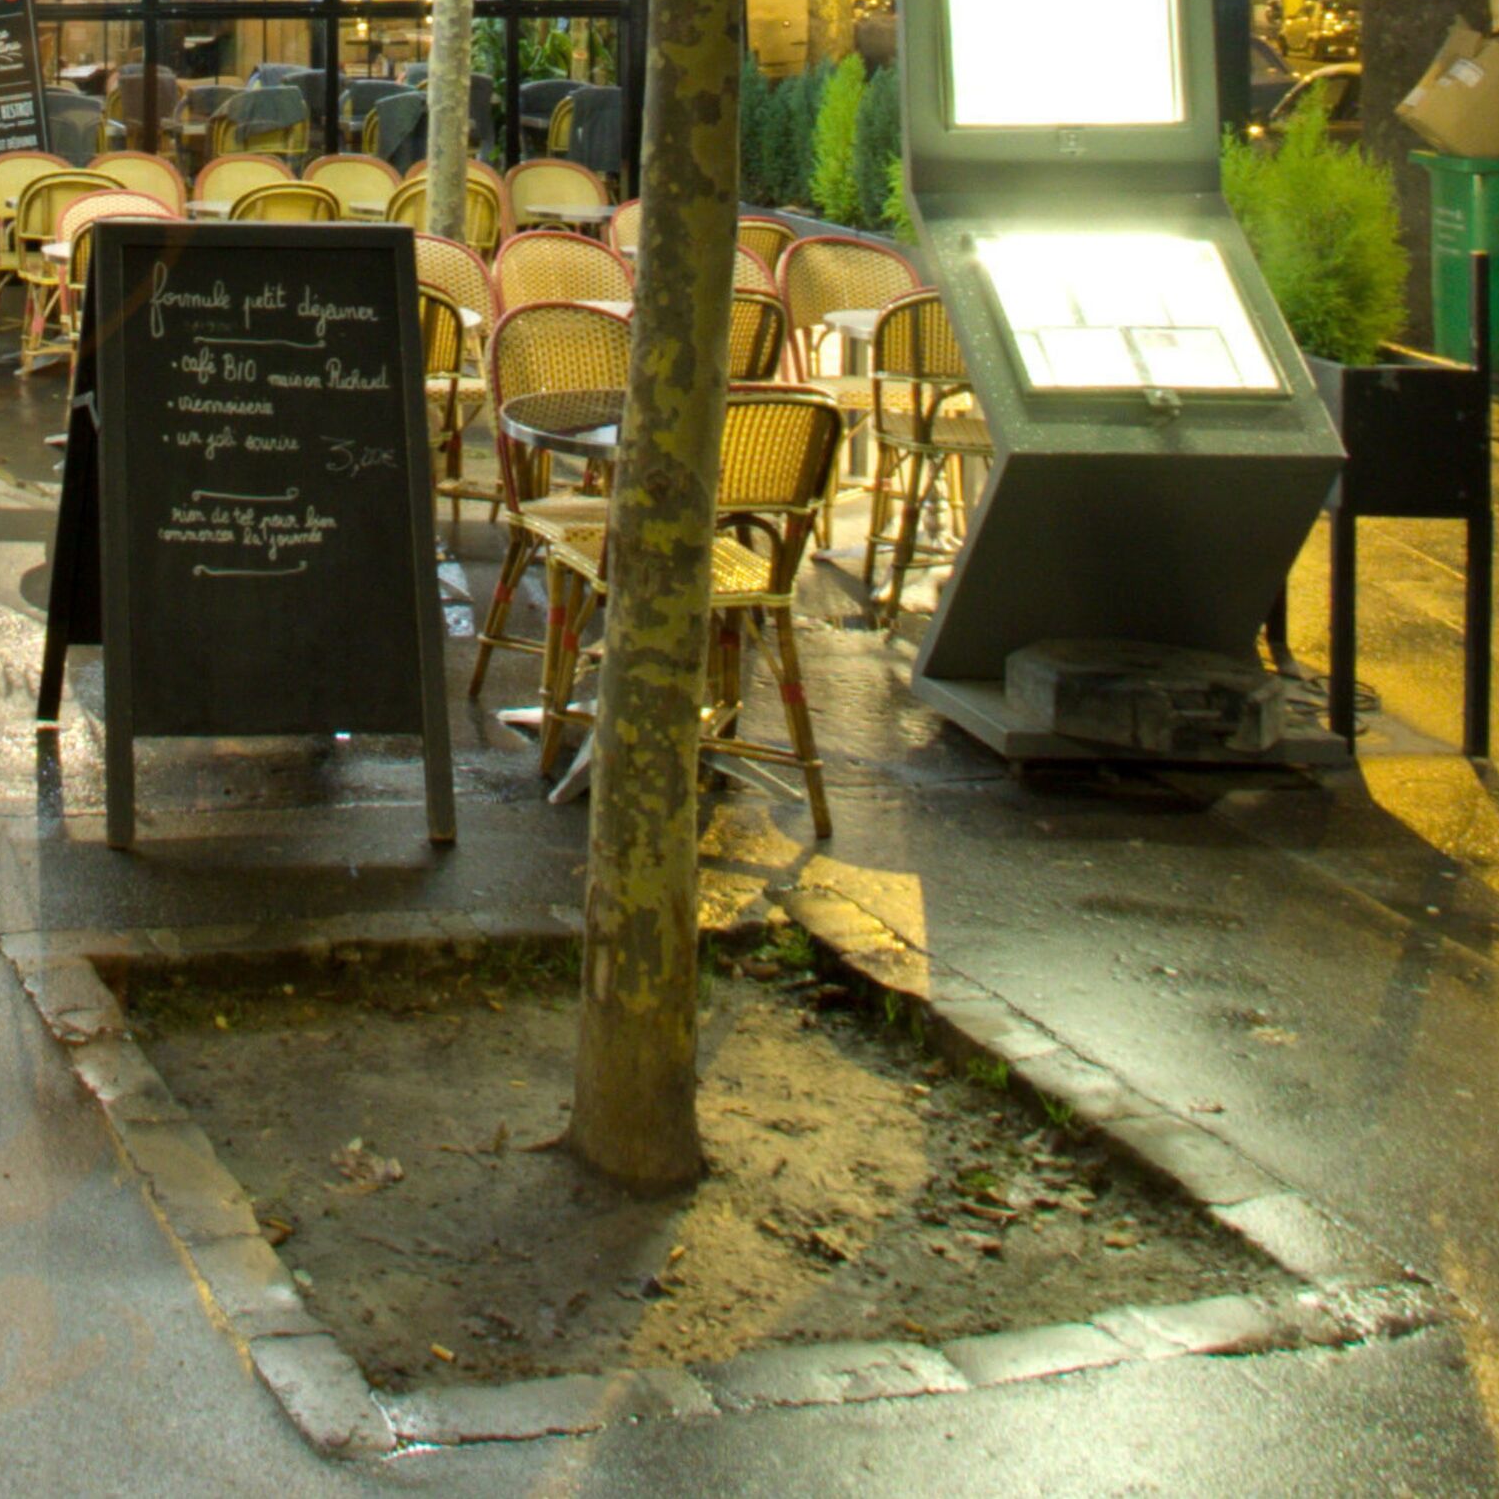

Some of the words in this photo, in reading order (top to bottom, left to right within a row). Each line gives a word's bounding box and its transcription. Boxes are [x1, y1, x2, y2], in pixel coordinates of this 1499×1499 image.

[150, 261, 232, 338] formule
[243, 282, 288, 333] petit
[297, 284, 380, 337] déjeuner
[180, 346, 218, 385] café
[324, 357, 391, 391] Richard
[176, 430, 203, 447] un
[204, 425, 238, 461] joli
[243, 434, 301, 452] sourire
[171, 503, 207, 523] rien
[210, 505, 231, 525] de
[232, 506, 256, 527] tel
[258, 514, 301, 541] pour
[304, 504, 338, 529] bien
[242, 526, 264, 546] la
[268, 529, 323, 562] journée
